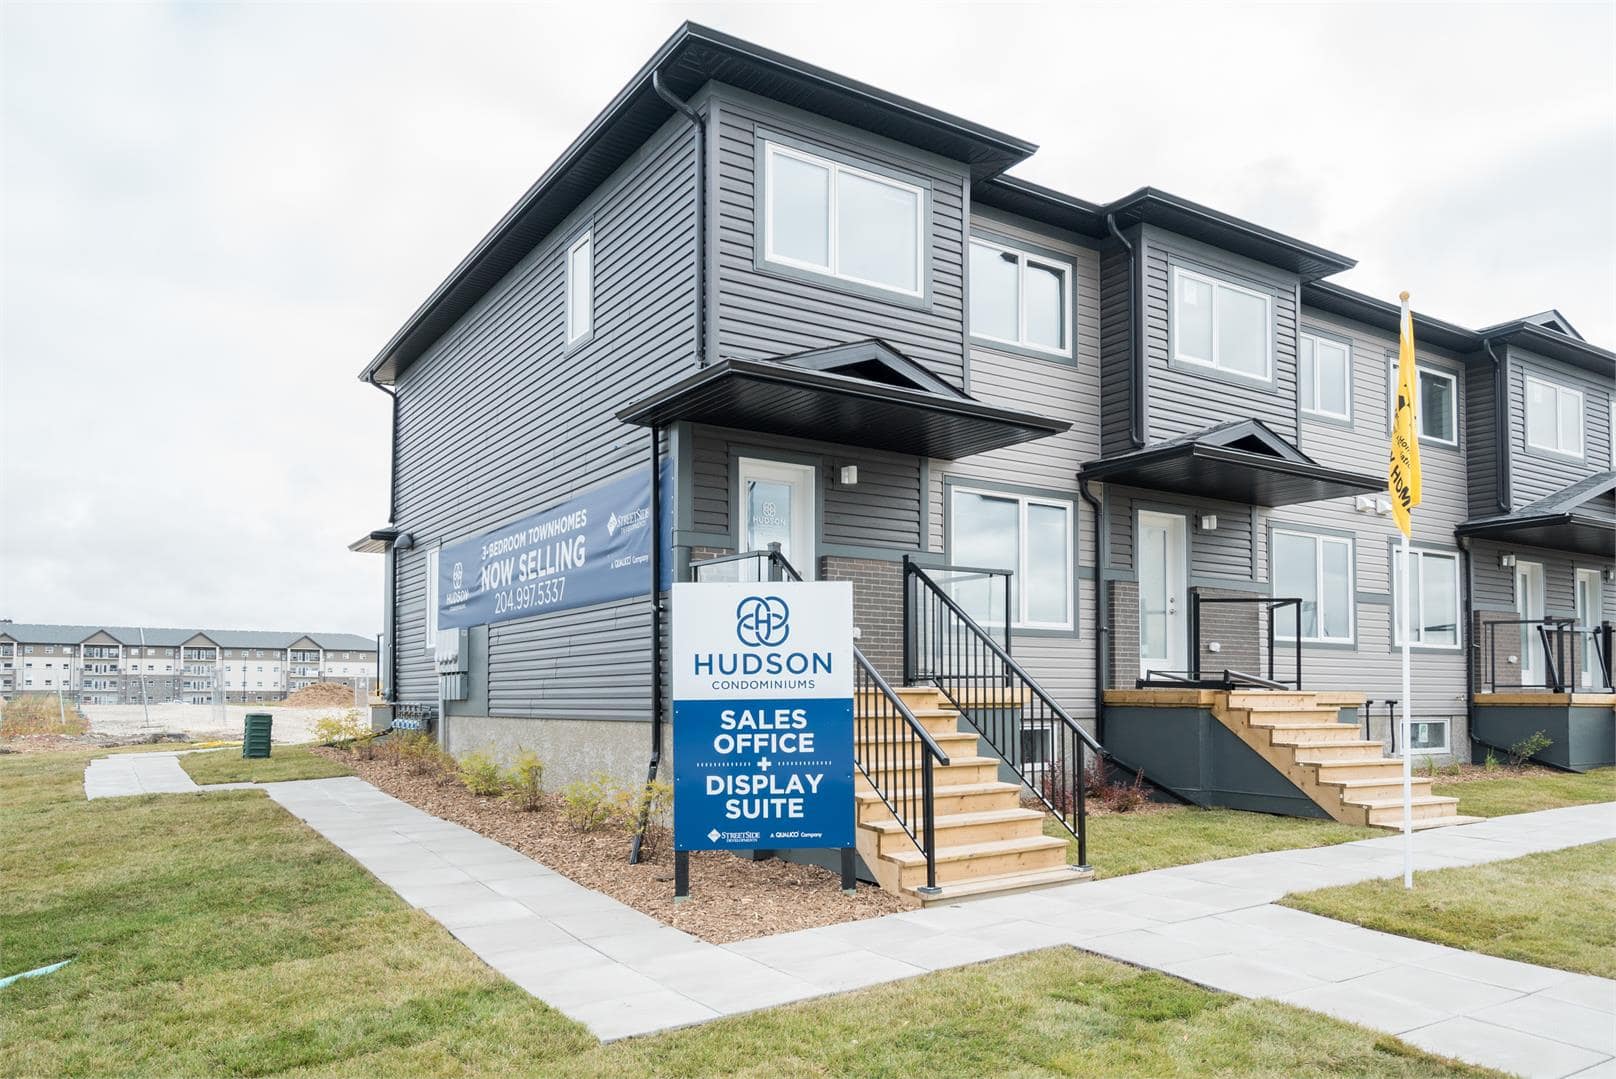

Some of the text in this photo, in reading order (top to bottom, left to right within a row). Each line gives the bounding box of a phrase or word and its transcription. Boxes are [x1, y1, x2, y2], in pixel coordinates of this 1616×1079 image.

[1390, 465, 1411, 513] HOM
[753, 515, 785, 527] HUDSON
[481, 531, 526, 560] 3-BEDROOM
[528, 509, 588, 543] TOWNHOMES
[481, 534, 586, 592] NOW SELLING
[446, 589, 469, 605] HUDSON
[495, 577, 566, 614] 204.997.5337
[694, 652, 832, 675] HUDSON
[711, 680, 816, 690] CONDOMINIUMS
[720, 709, 808, 730] SALES
[713, 733, 815, 754] OFFICE
[706, 773, 824, 795] DISPLAY
[725, 798, 805, 819] SUITE
